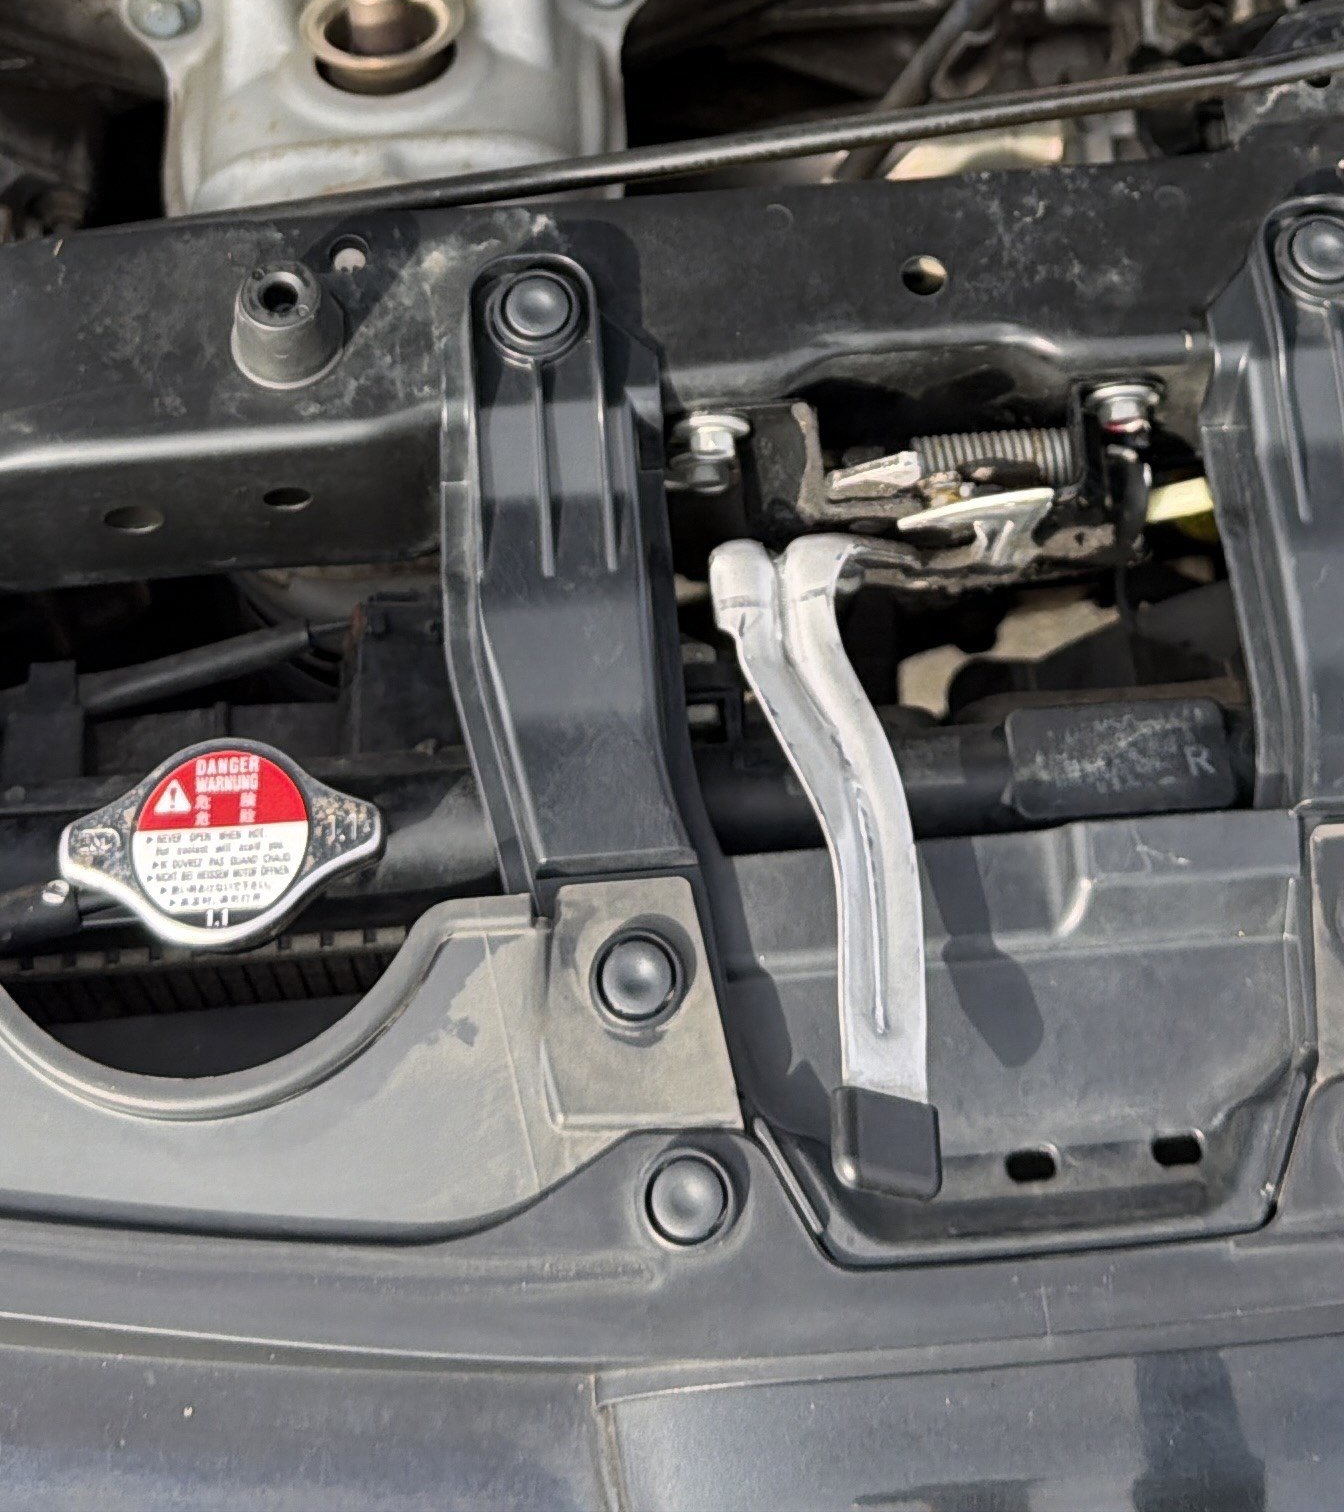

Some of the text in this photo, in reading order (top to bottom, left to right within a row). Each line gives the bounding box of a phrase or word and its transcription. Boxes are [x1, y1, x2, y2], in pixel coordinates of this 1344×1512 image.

[195, 754, 261, 776] DANGER
[1183, 744, 1216, 777] R
[195, 773, 259, 793] WARNUNG
[189, 832, 211, 843] OPEN
[219, 830, 241, 840] WHEN
[206, 908, 229, 927] 1.1
